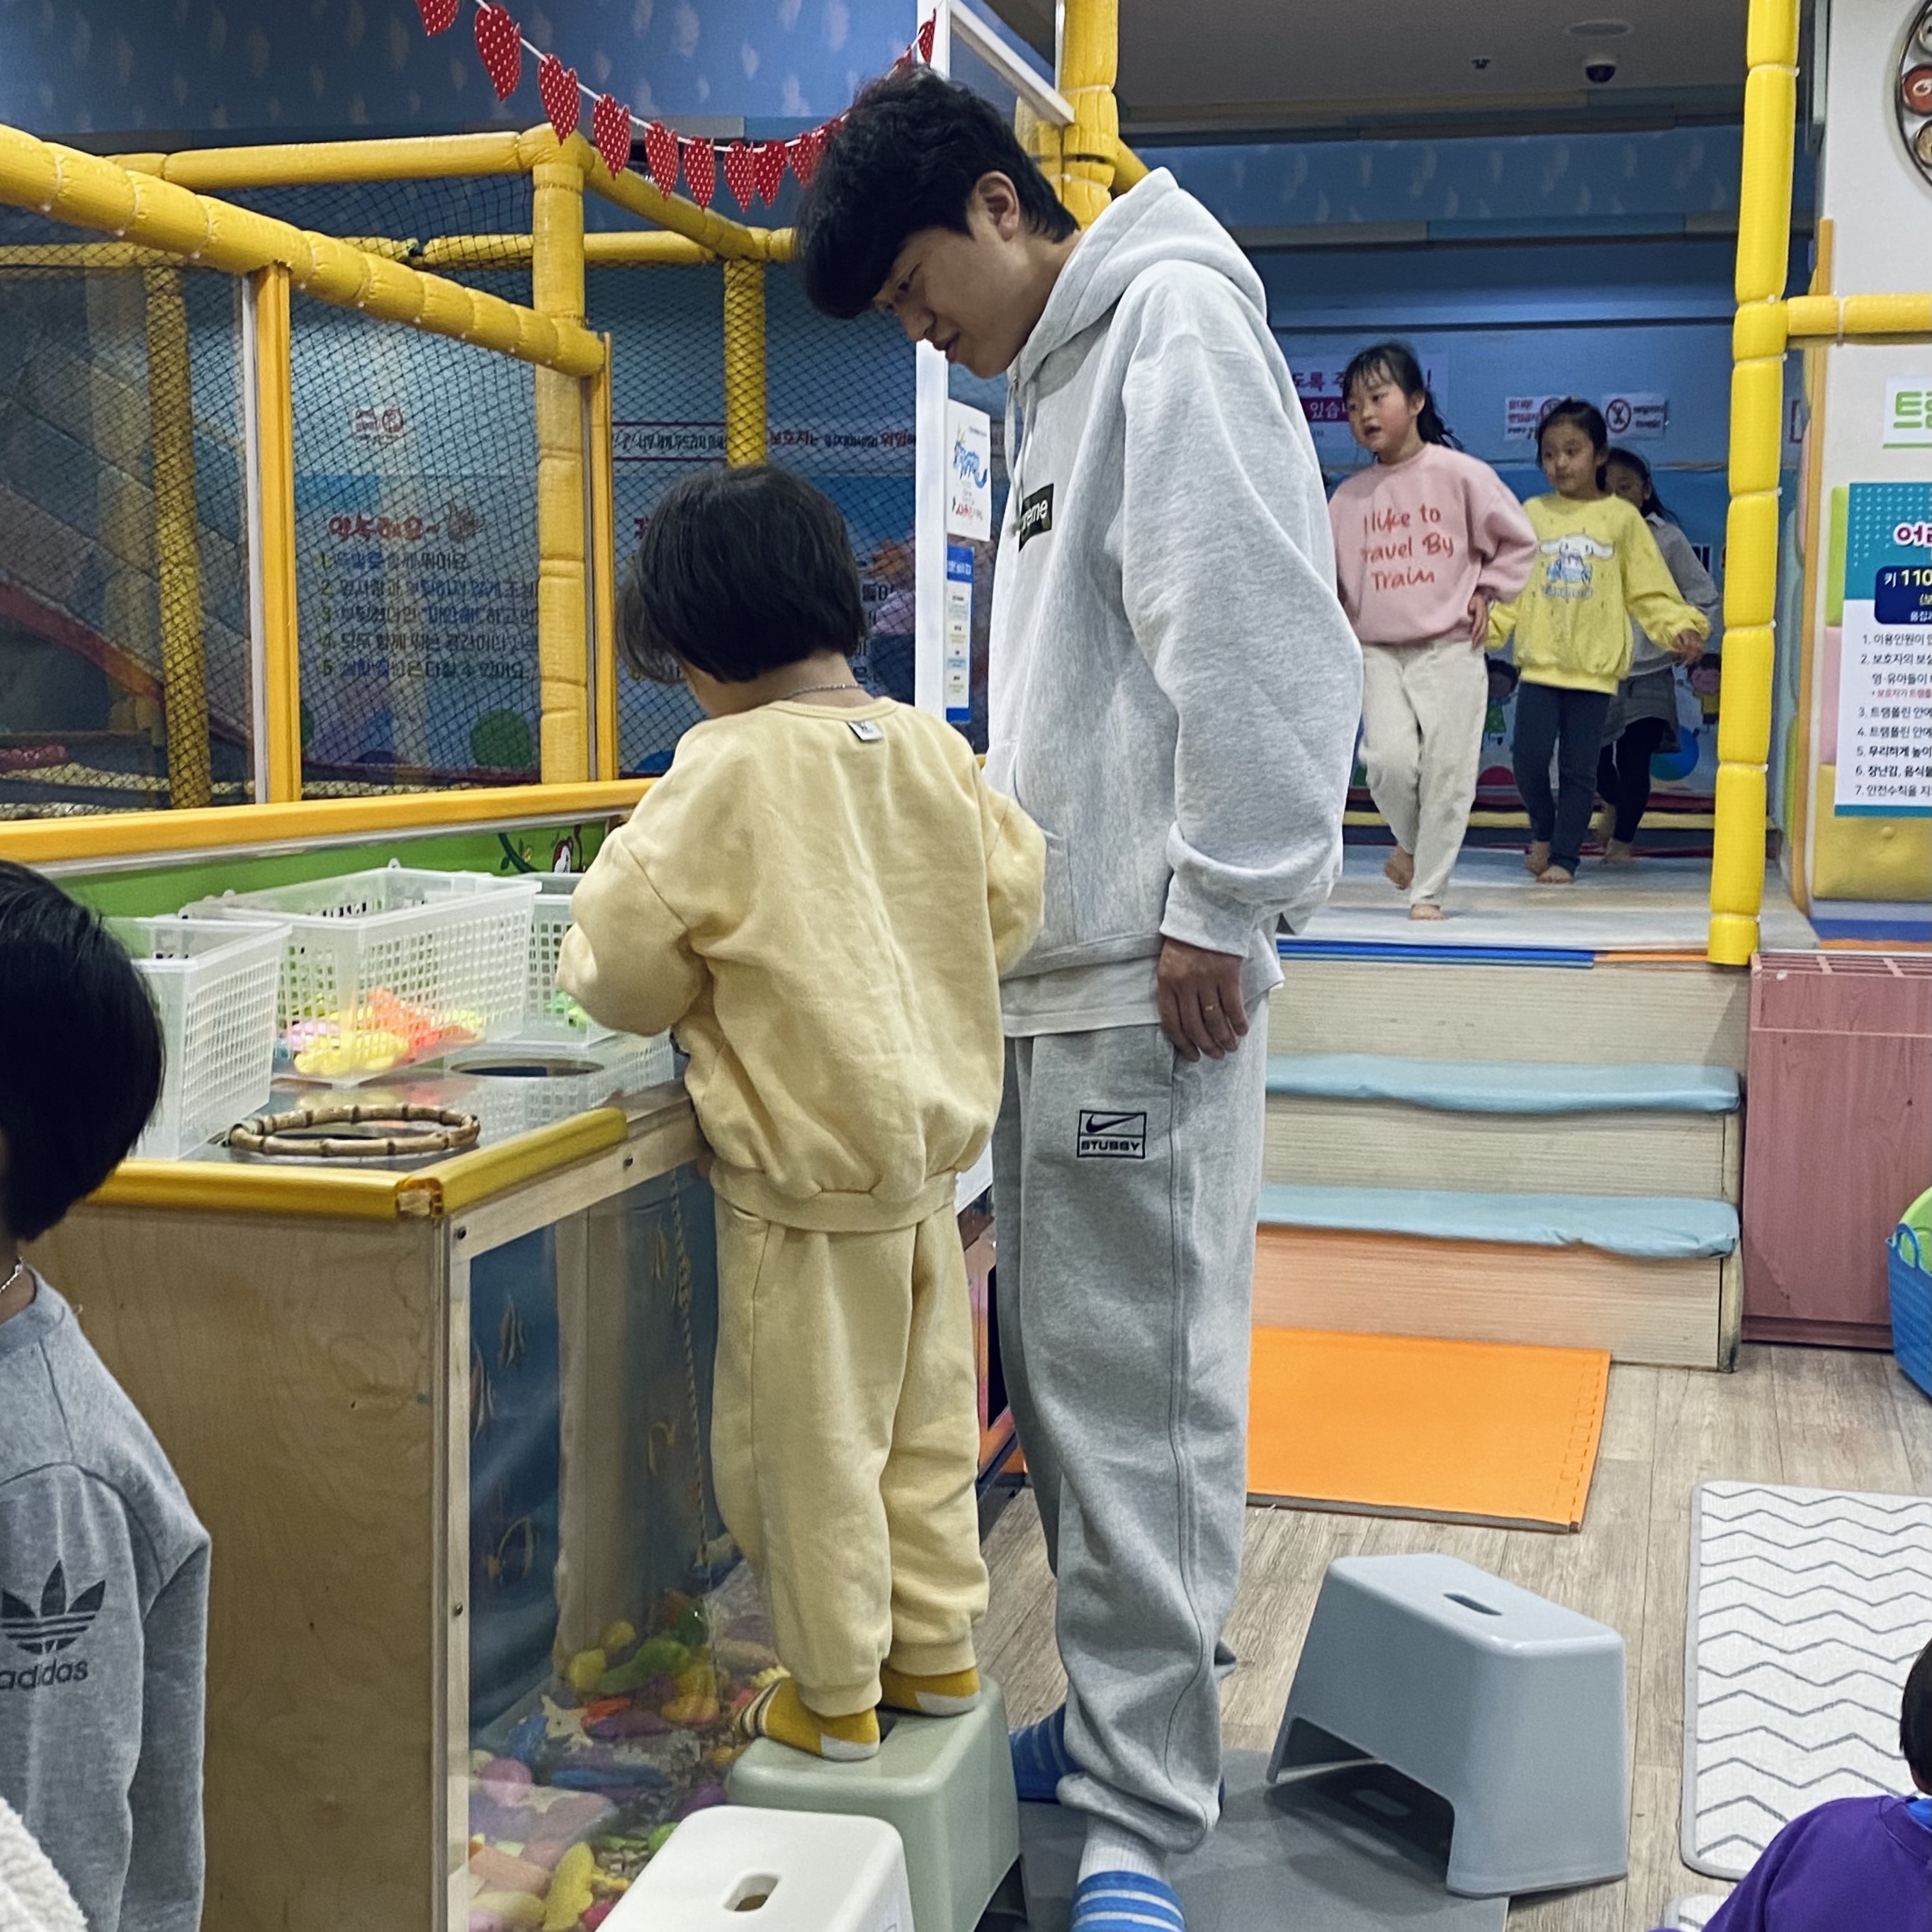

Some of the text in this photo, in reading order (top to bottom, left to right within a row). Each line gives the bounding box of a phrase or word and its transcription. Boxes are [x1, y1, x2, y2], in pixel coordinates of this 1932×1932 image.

[1372, 508, 1410, 533] like
[1420, 504, 1441, 523] to
[1422, 532, 1454, 558] By
[1372, 567, 1435, 592] Train
[1885, 569, 1932, 588] 키 110
[0, 1657, 88, 1689] adidas
